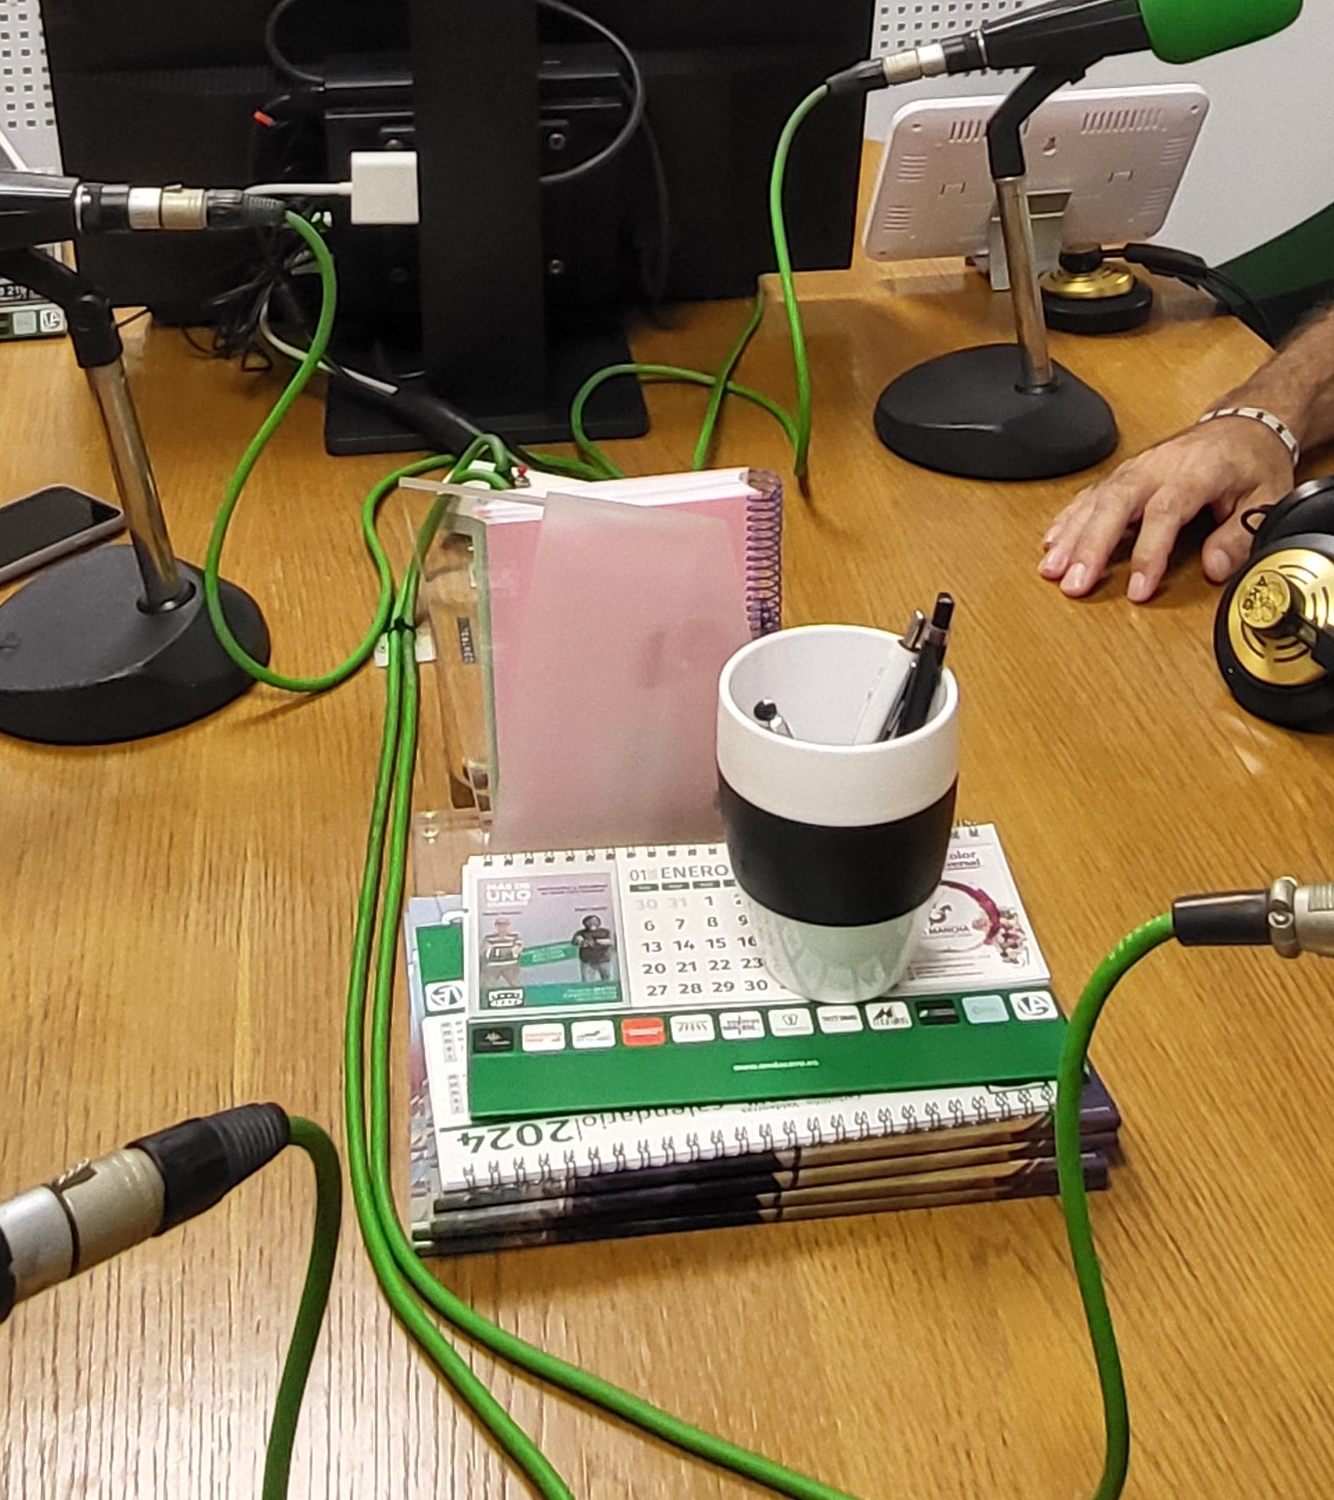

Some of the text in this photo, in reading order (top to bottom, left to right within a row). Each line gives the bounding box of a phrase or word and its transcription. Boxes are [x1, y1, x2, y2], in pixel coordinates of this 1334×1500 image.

[949, 850, 977, 860] olor
[629, 864, 730, 882] 01 ENERO
[485, 890, 532, 902] UNO
[704, 895, 714, 907] 1
[644, 914, 749, 932] 6 7 8 9
[641, 935, 758, 953] 13 14 15 16
[642, 957, 764, 975] 20 21 22 23
[646, 979, 768, 997] 27 28 29 30
[457, 1117, 574, 1153] 2024
